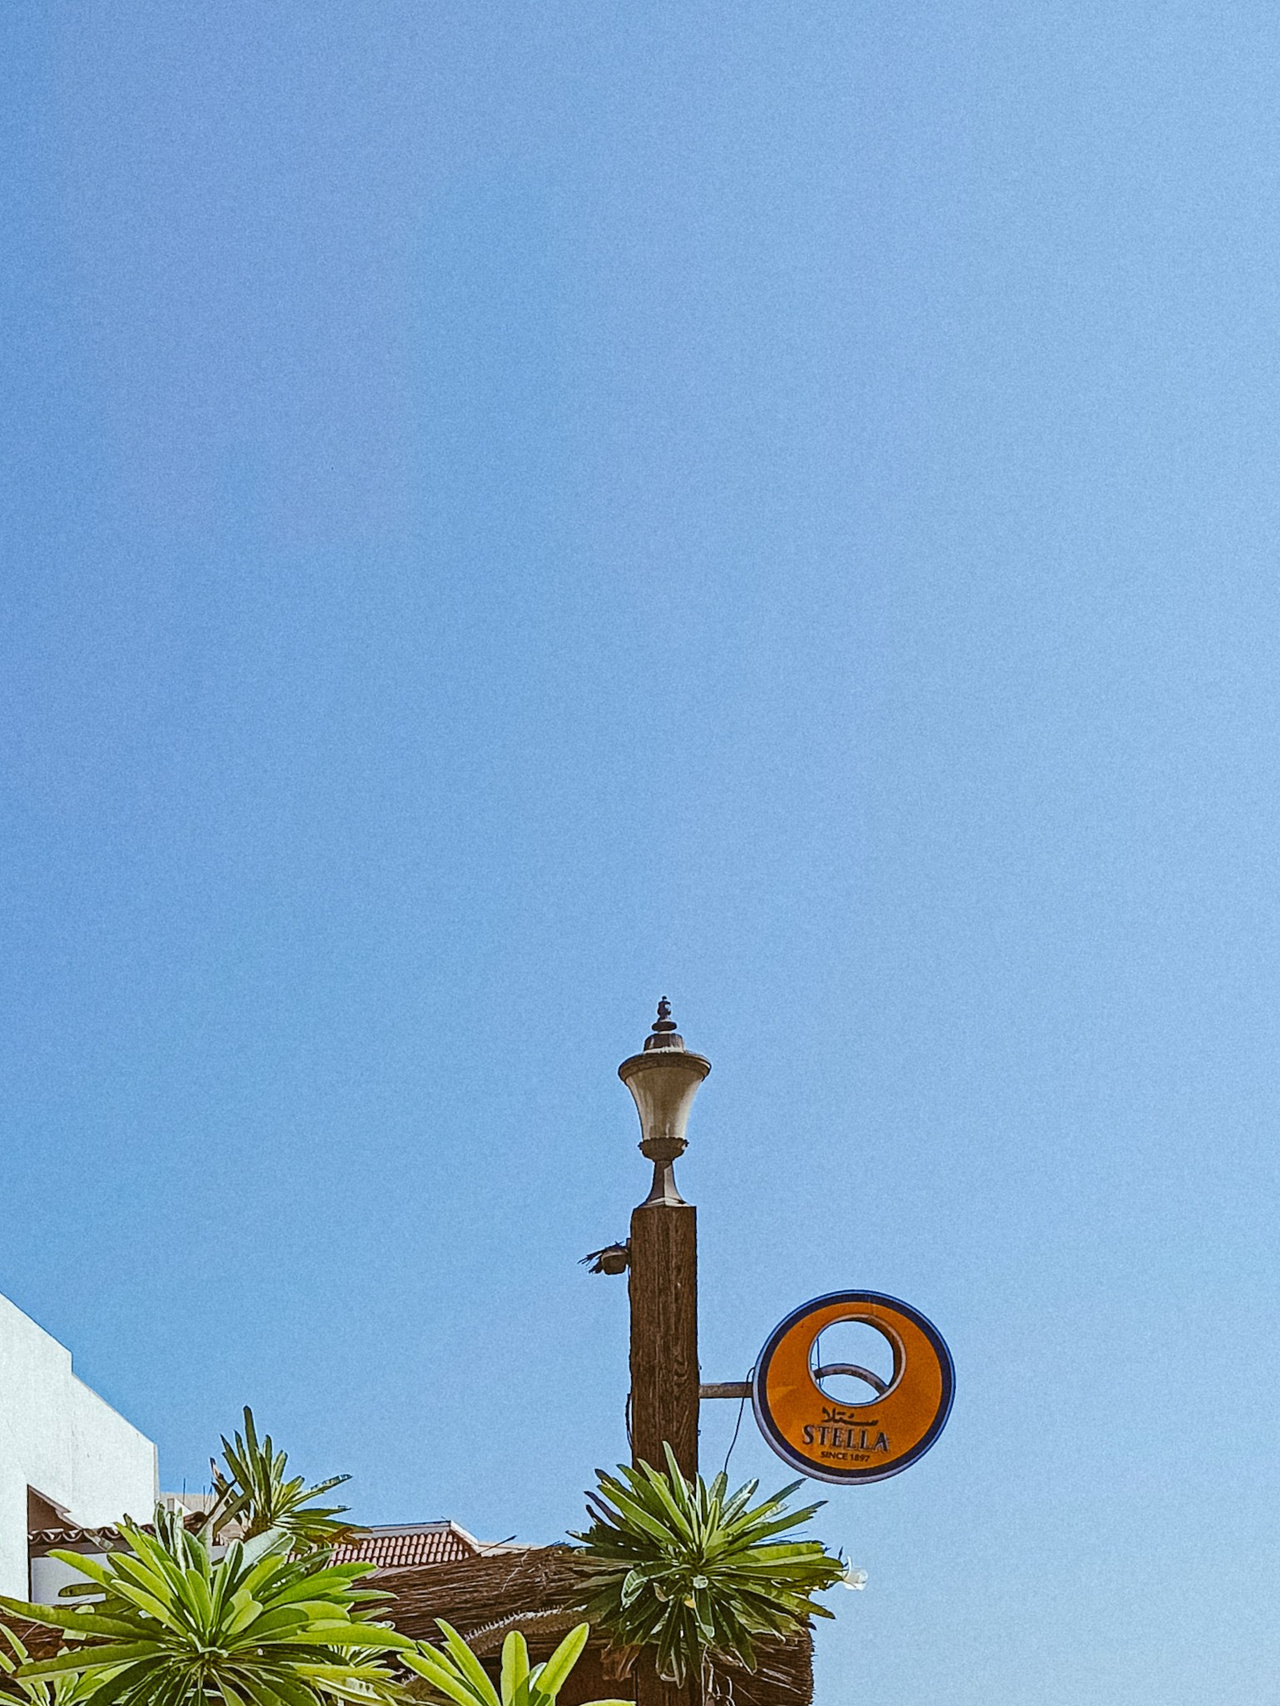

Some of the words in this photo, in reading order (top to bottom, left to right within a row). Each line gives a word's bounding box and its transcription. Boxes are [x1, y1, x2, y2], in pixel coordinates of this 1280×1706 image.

[802, 1424, 890, 1452] STELLA
[821, 1451, 848, 1461] SINCE
[850, 1454, 870, 1462] 1897
